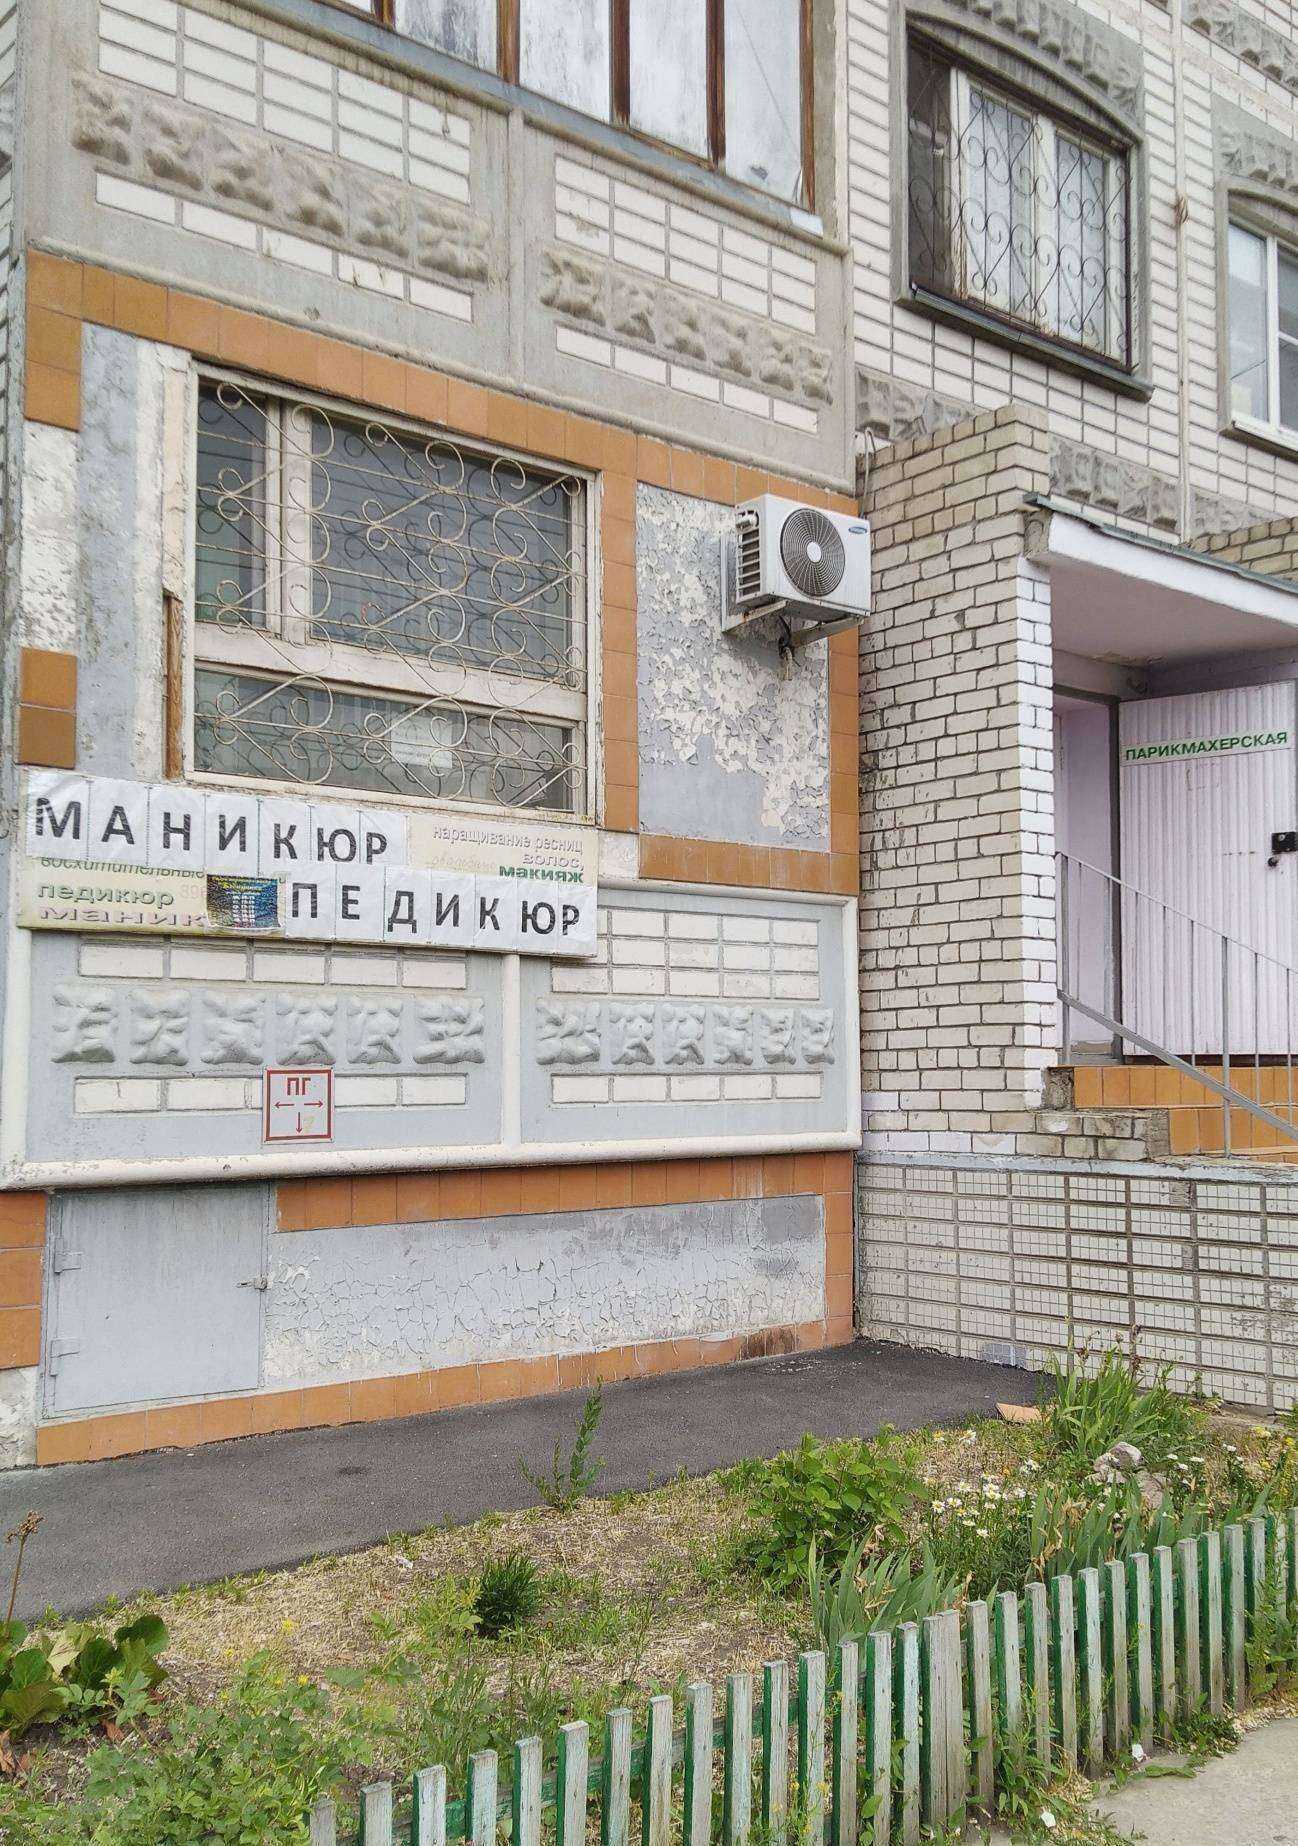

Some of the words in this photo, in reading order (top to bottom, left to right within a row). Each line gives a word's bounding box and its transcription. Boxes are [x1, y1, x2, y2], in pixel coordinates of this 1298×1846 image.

[1126, 731, 1288, 761] ПАРИКМАХЕРСКАЯ
[35, 797, 388, 865] МАНИКЮР
[432, 824, 531, 848] наращивание
[534, 836, 584, 855] ресниц
[499, 865, 584, 884] макияж
[38, 884, 174, 910] педикюр
[291, 881, 580, 936] ПЕДИКЮР
[287, 1077, 312, 1096] ПГ
